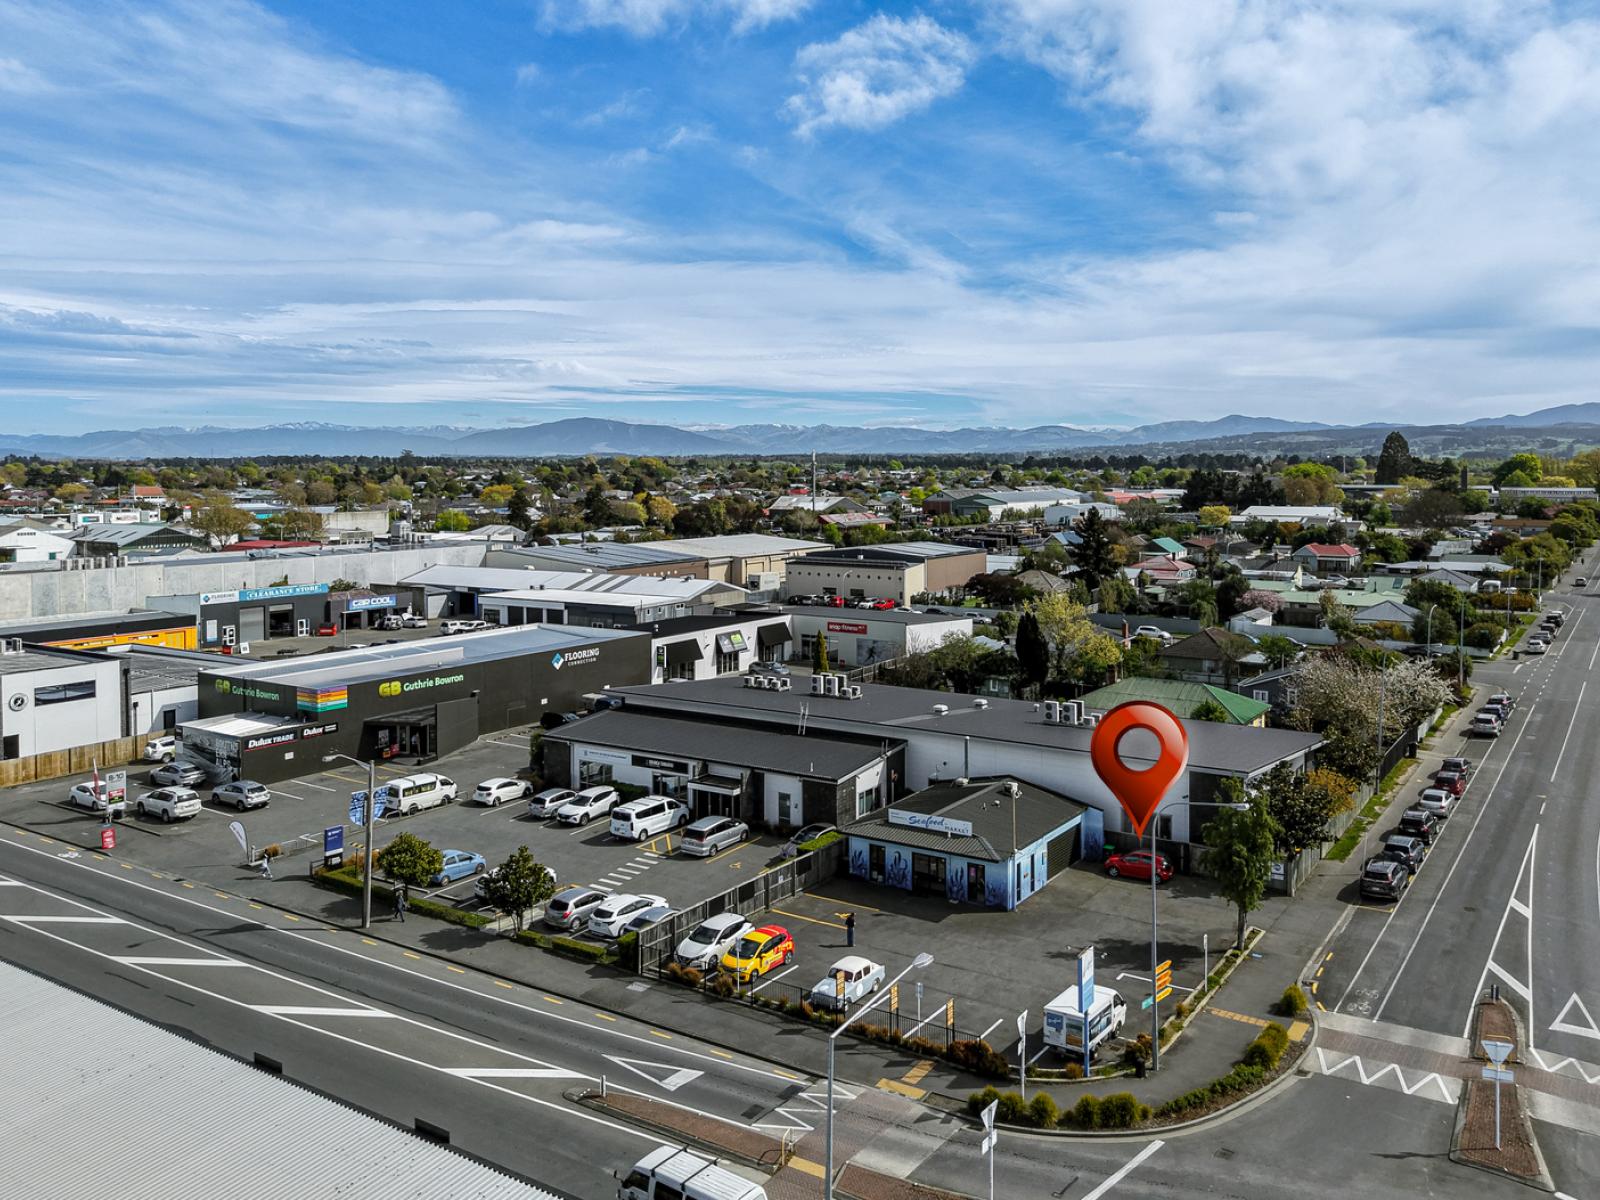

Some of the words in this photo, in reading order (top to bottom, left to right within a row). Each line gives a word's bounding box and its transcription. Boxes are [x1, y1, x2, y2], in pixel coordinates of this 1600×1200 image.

[564, 647, 600, 662] FLOORING
[403, 679, 434, 692] Guthrie
[435, 674, 464, 686] Bowron
[303, 727, 324, 737] Dulux
[248, 738, 272, 749] Dulux
[273, 733, 295, 744] TRADE
[908, 815, 945, 828] Seafood
[944, 825, 969, 834] MARKET
